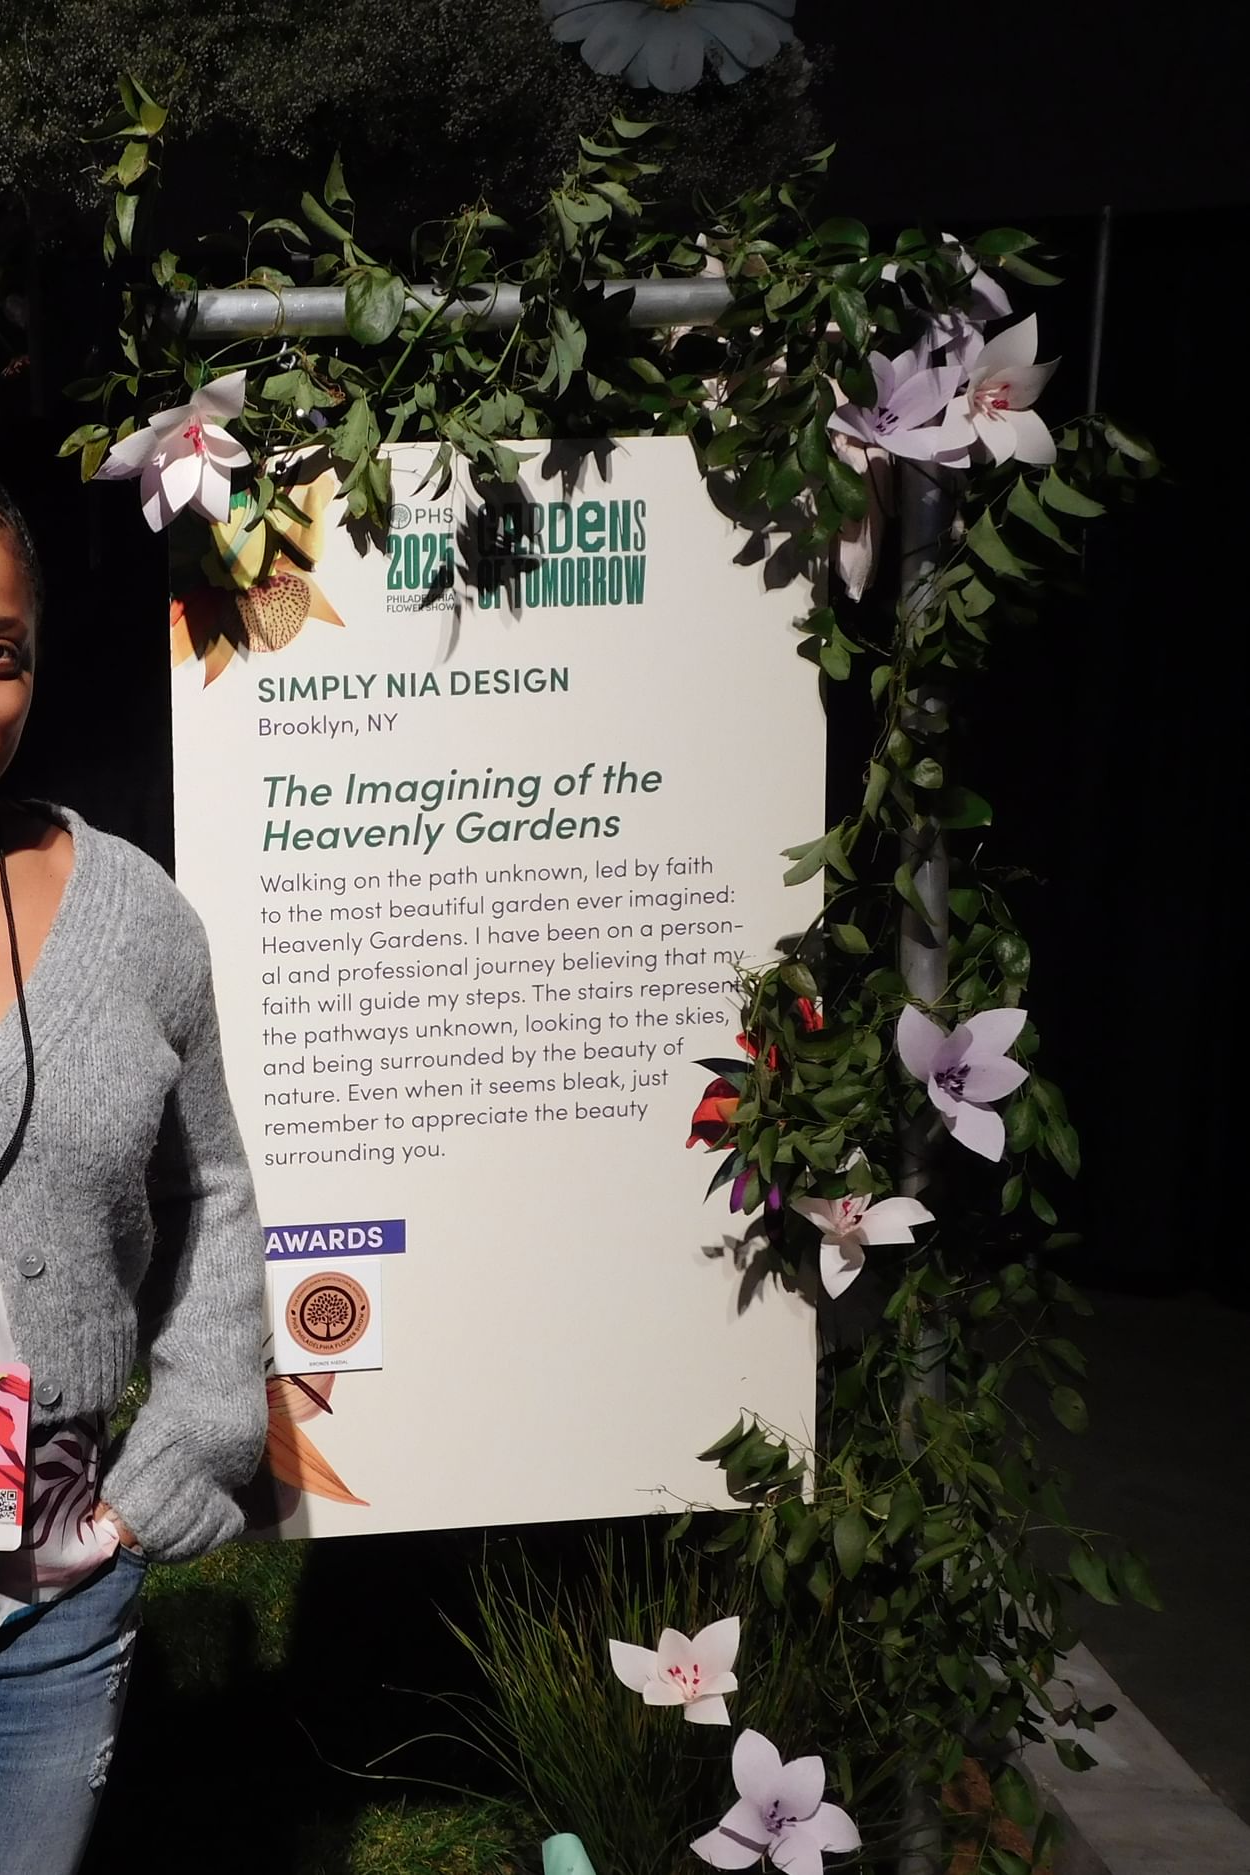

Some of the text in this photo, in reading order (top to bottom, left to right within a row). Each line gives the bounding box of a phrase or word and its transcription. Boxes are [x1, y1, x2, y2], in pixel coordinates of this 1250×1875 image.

[414, 507, 454, 525] PHS
[386, 532, 455, 591] 2025
[386, 593, 455, 604] PHILADEHIA
[477, 554, 647, 610] OF TOMORROW
[386, 602, 455, 614] FLOWER SHOW
[257, 666, 569, 704] SIMPLY NIA DESIGN
[258, 712, 399, 740] Brooklyn, NY
[262, 760, 663, 813] The Imagining of the
[262, 807, 621, 856] Heavenly Gardens
[259, 855, 713, 896] Walking on the path unknown, led by faith
[260, 884, 735, 924] to the most beautiful garden ever imagined:
[262, 920, 744, 957] Heavenly Gardens. I have been on a person-
[261, 947, 745, 988] al and professional journey believing that my
[261, 976, 741, 1017] faith will guide my steps. The stairs represent
[262, 1005, 731, 1050] the pathways unknown, looking to the skies,
[263, 1036, 685, 1077] and being surrounded by the beauty of
[264, 1068, 669, 1106] nature. Even when it seems bleak, just
[264, 1100, 649, 1137] remember to appreciate the beauty
[264, 1142, 446, 1166] surrounding you.
[265, 1227, 384, 1254] AWARDS
[296, 1329, 334, 1350] PHILADELPHIA
[335, 1332, 357, 1349] FLOWER
